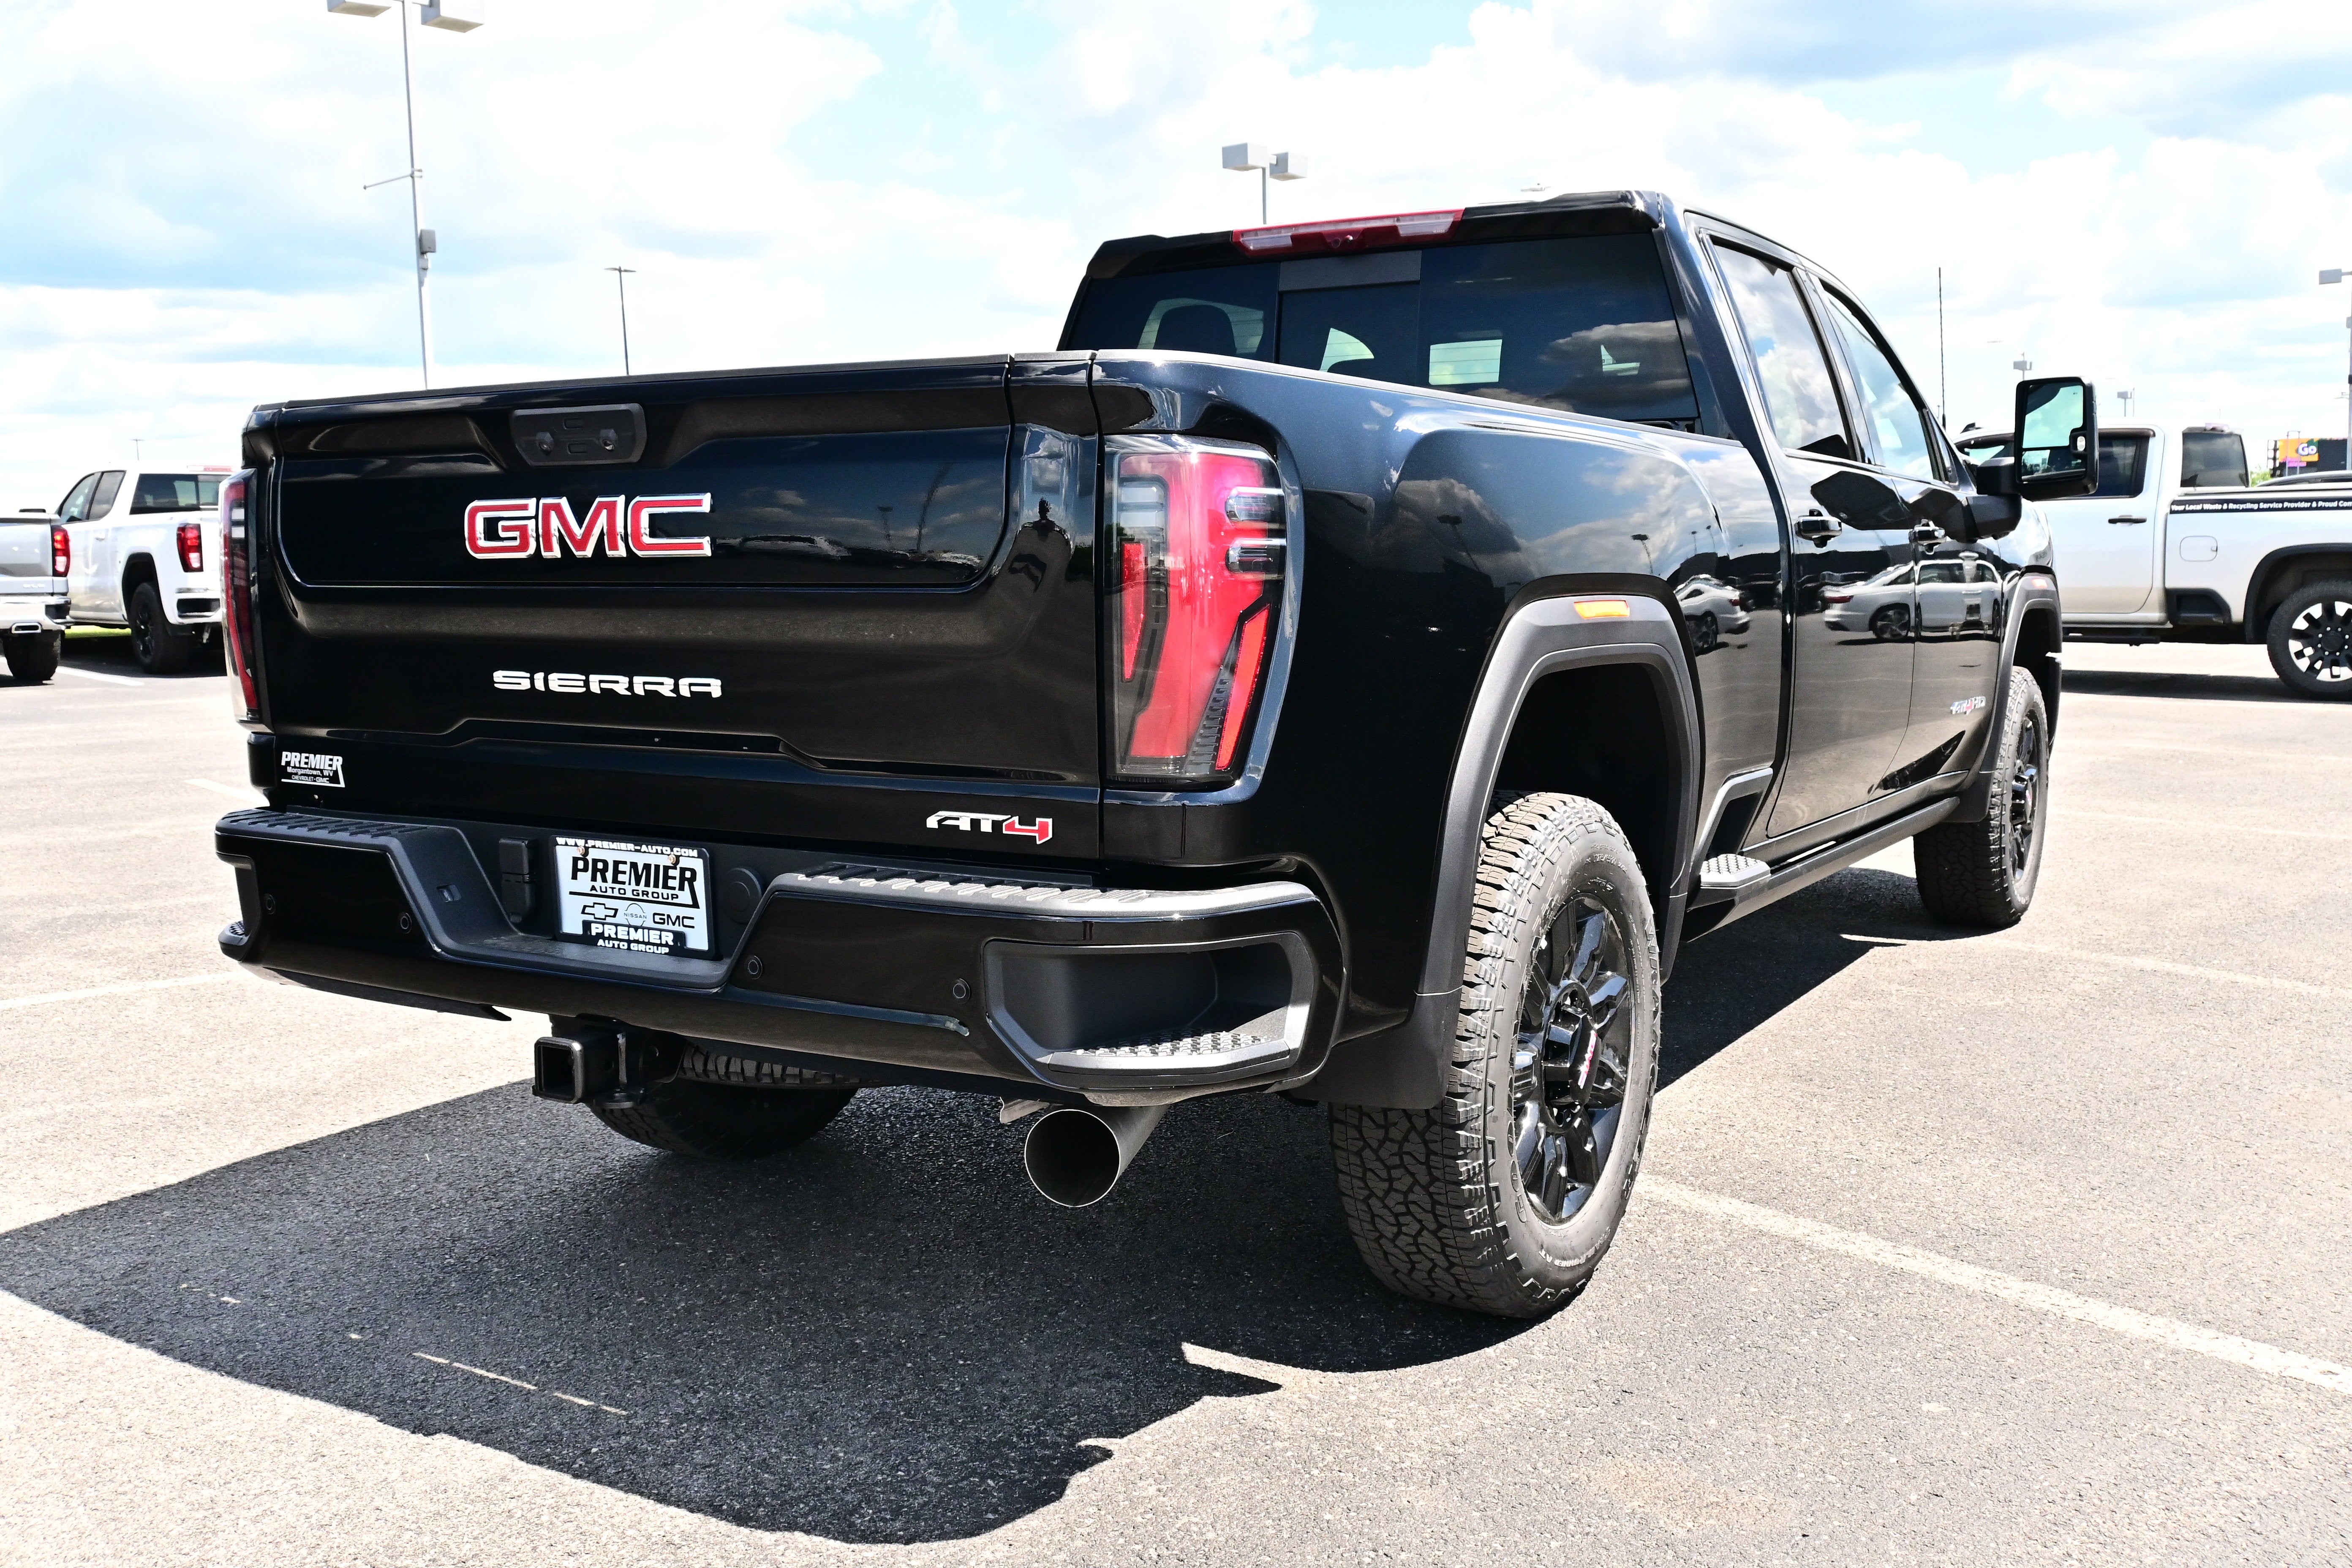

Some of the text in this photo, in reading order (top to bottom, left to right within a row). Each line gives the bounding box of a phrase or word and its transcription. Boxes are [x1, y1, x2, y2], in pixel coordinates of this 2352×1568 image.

[2298, 443, 2317, 456] Go
[464, 493, 712, 558] GMC
[493, 670, 722, 698] SIERRA
[281, 751, 343, 770] PREMIER
[287, 766, 322, 776] Morgantown,
[926, 811, 1052, 844] AT4
[555, 837, 698, 857] WWW.PREMIER-AUTO.COM
[571, 856, 697, 892] PREMIER
[590, 885, 679, 901] AUTO GROUP
[653, 912, 695, 928] GMC
[591, 923, 674, 946] PREMIER
[597, 939, 670, 954] AUTO GROUP
